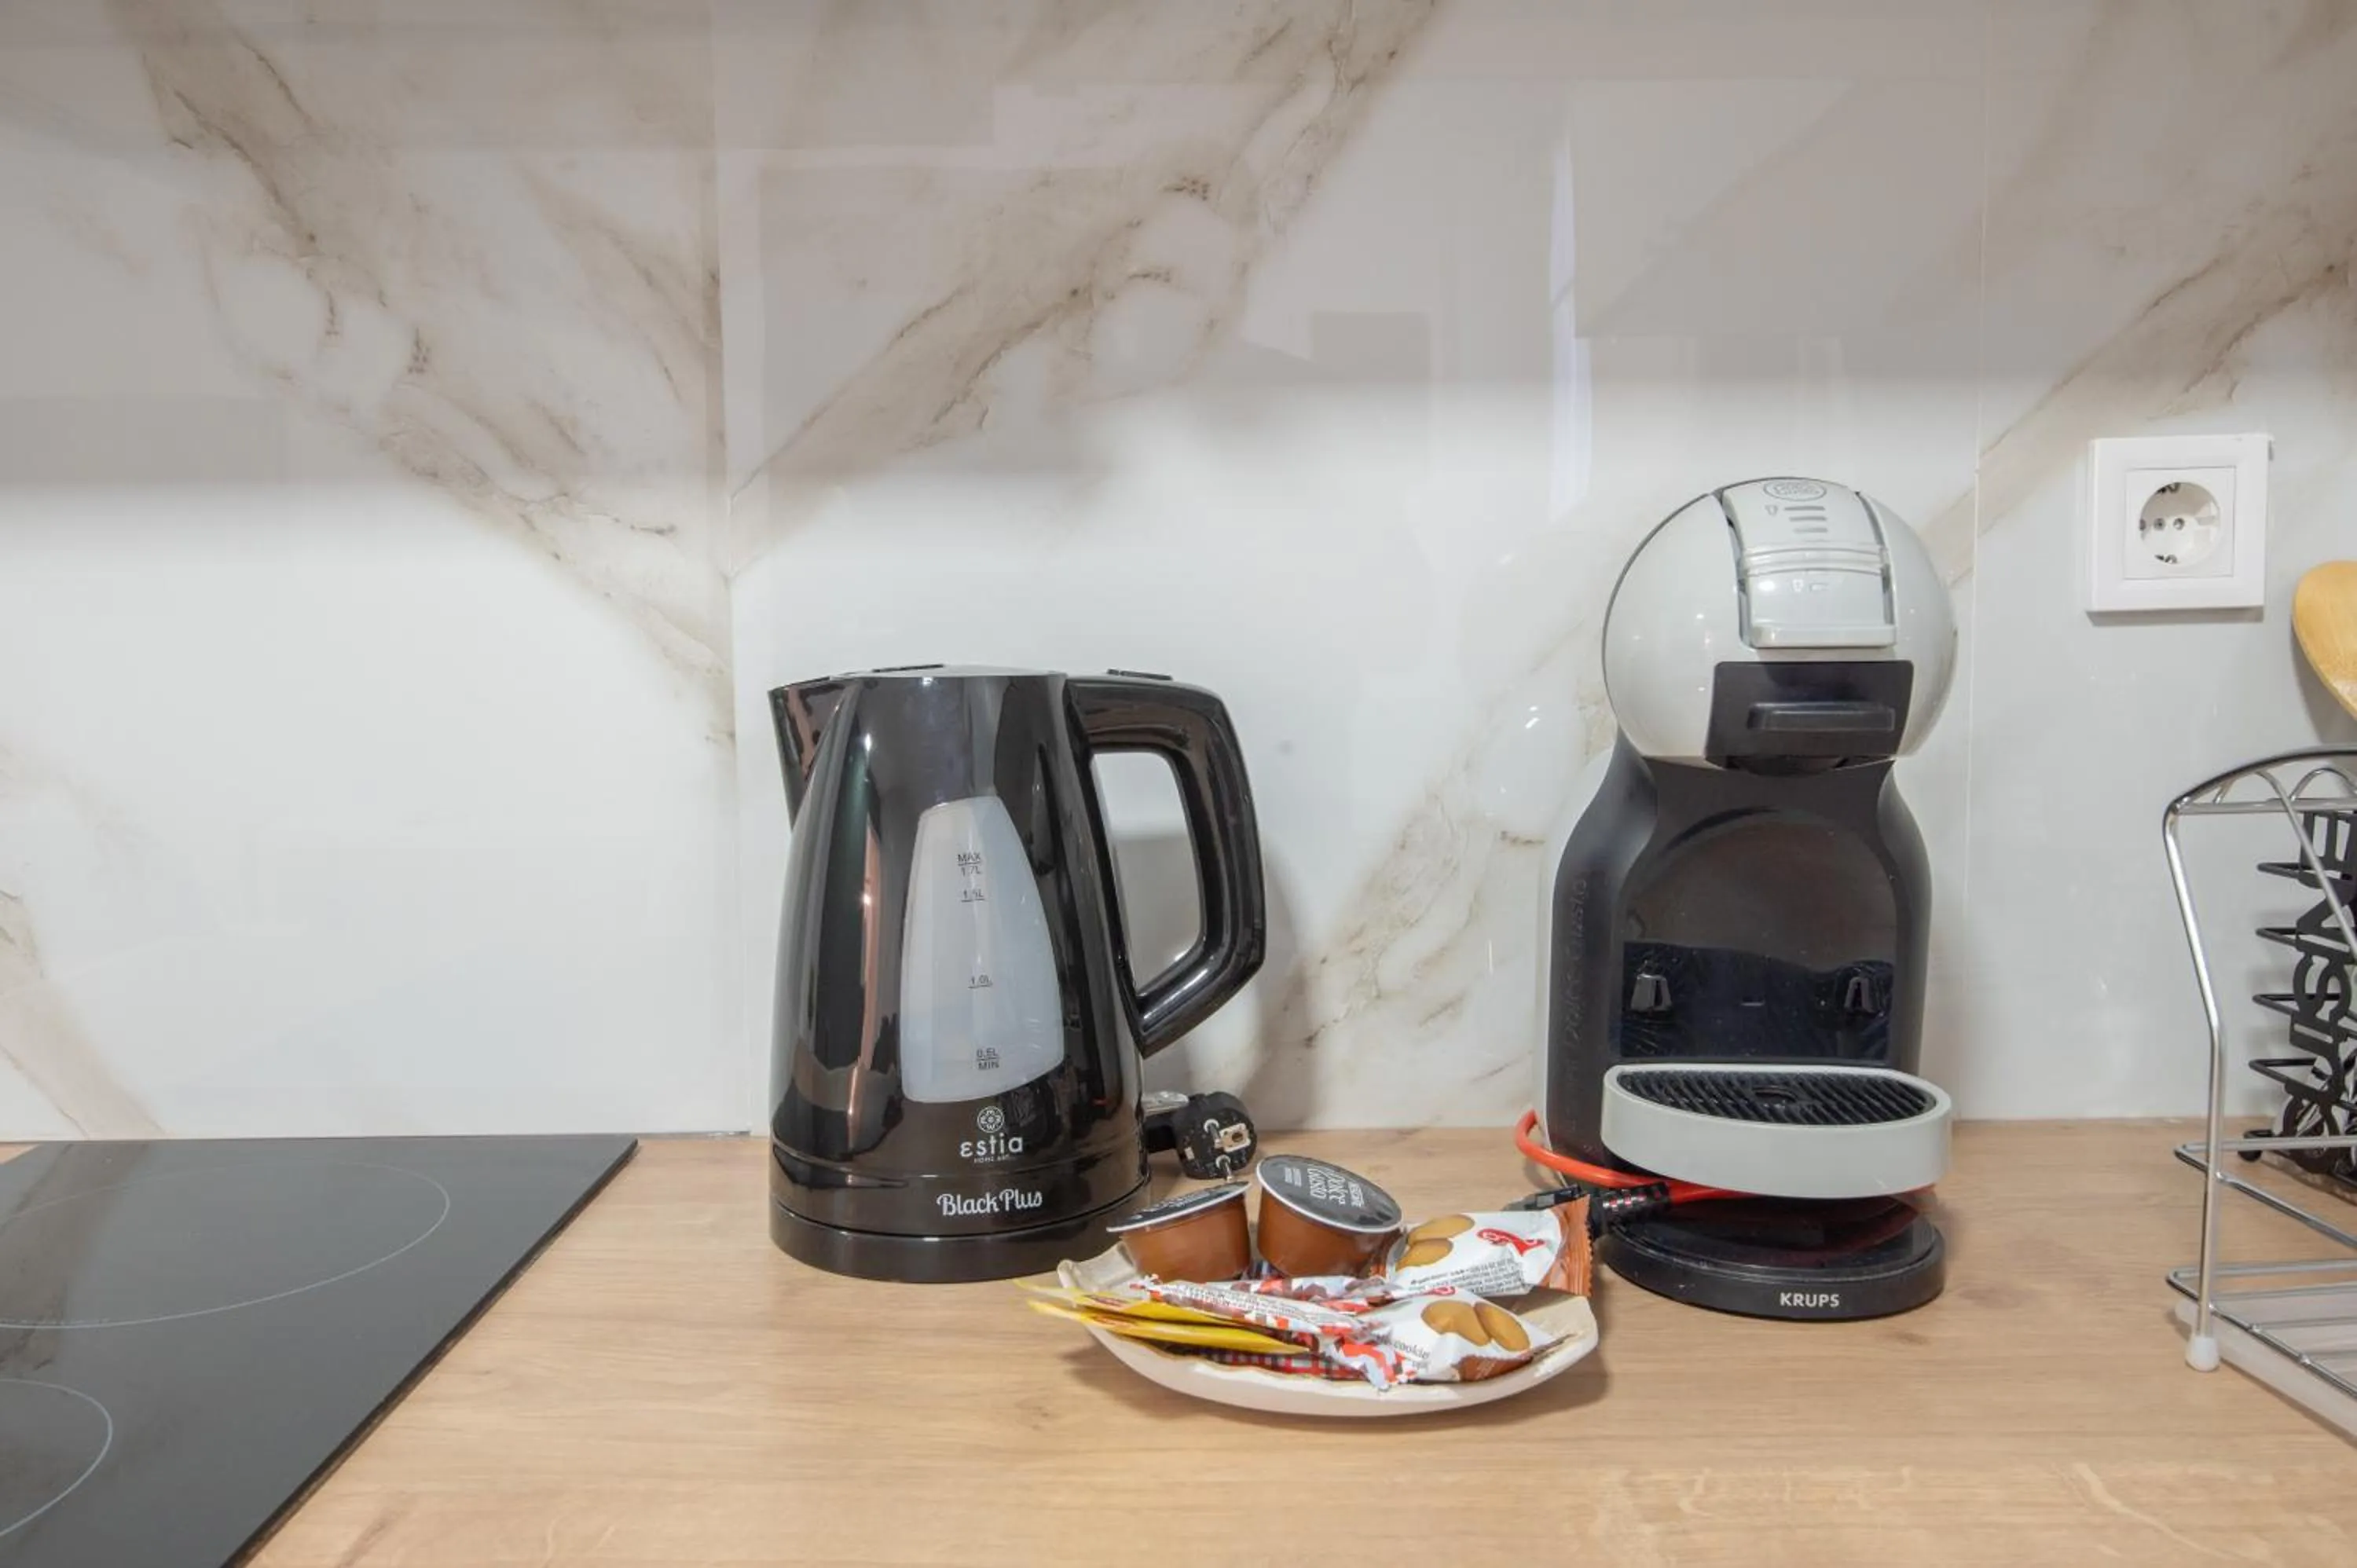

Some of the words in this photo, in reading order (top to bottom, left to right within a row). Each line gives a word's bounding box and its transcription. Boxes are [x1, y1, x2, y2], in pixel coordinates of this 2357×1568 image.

[957, 852, 981, 863] MAX
[937, 1192, 999, 1216] Black
[999, 1189, 1043, 1212] Plus
[1780, 1292, 1840, 1308] KRUPS
